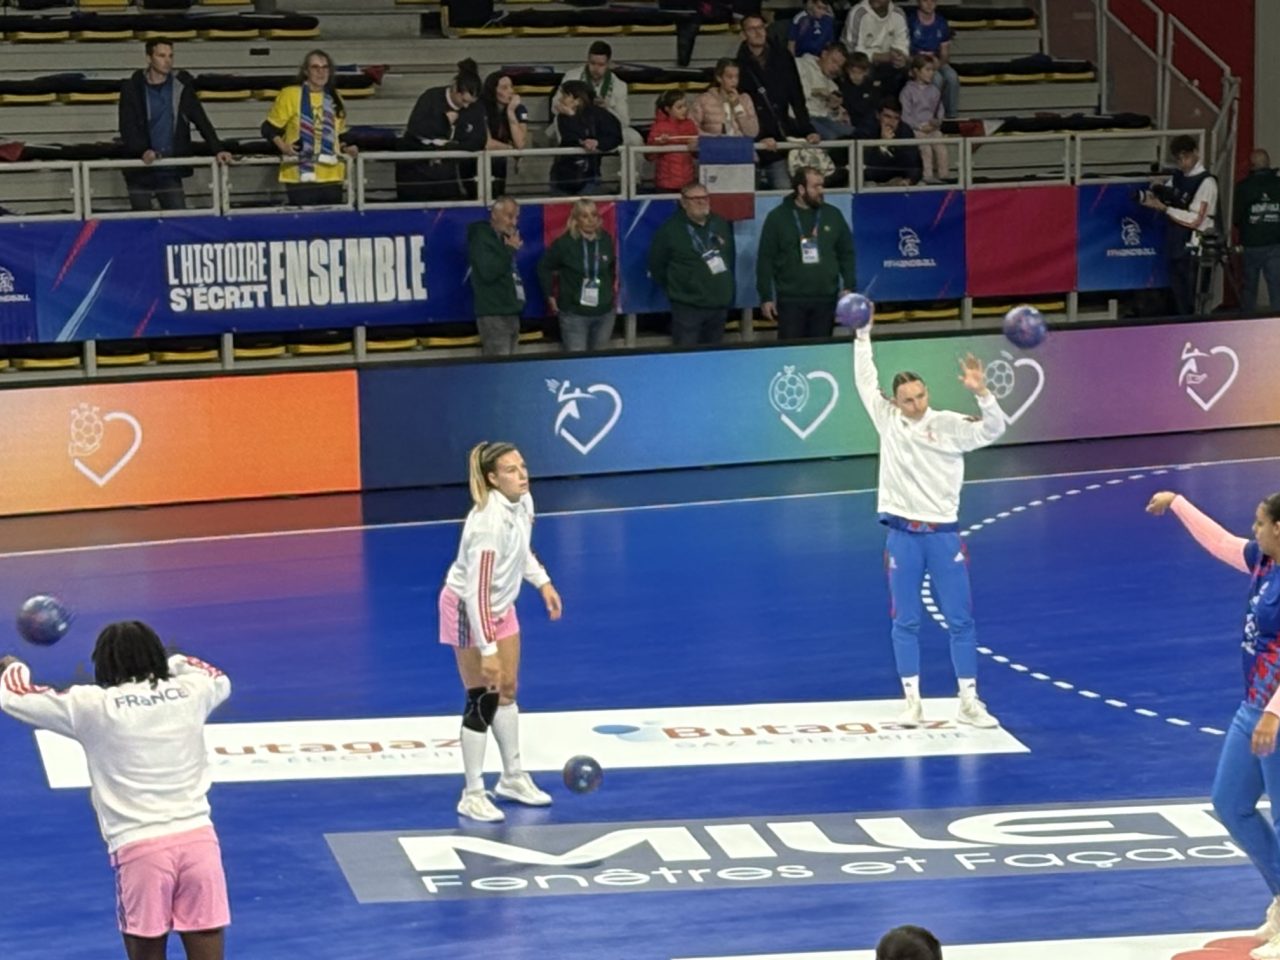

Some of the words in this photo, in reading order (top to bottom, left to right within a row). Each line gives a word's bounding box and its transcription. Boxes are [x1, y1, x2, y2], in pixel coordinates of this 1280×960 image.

[166, 241, 267, 286] L'HISTOIRE
[269, 235, 428, 308] ENSEMBLE
[170, 284, 268, 312] S'ÉCRIT
[213, 737, 463, 756] utagaz
[661, 719, 957, 740] Butagaz
[398, 800, 1273, 872] MILLET
[420, 863, 815, 894] Fenêtres
[840, 854, 928, 876] et
